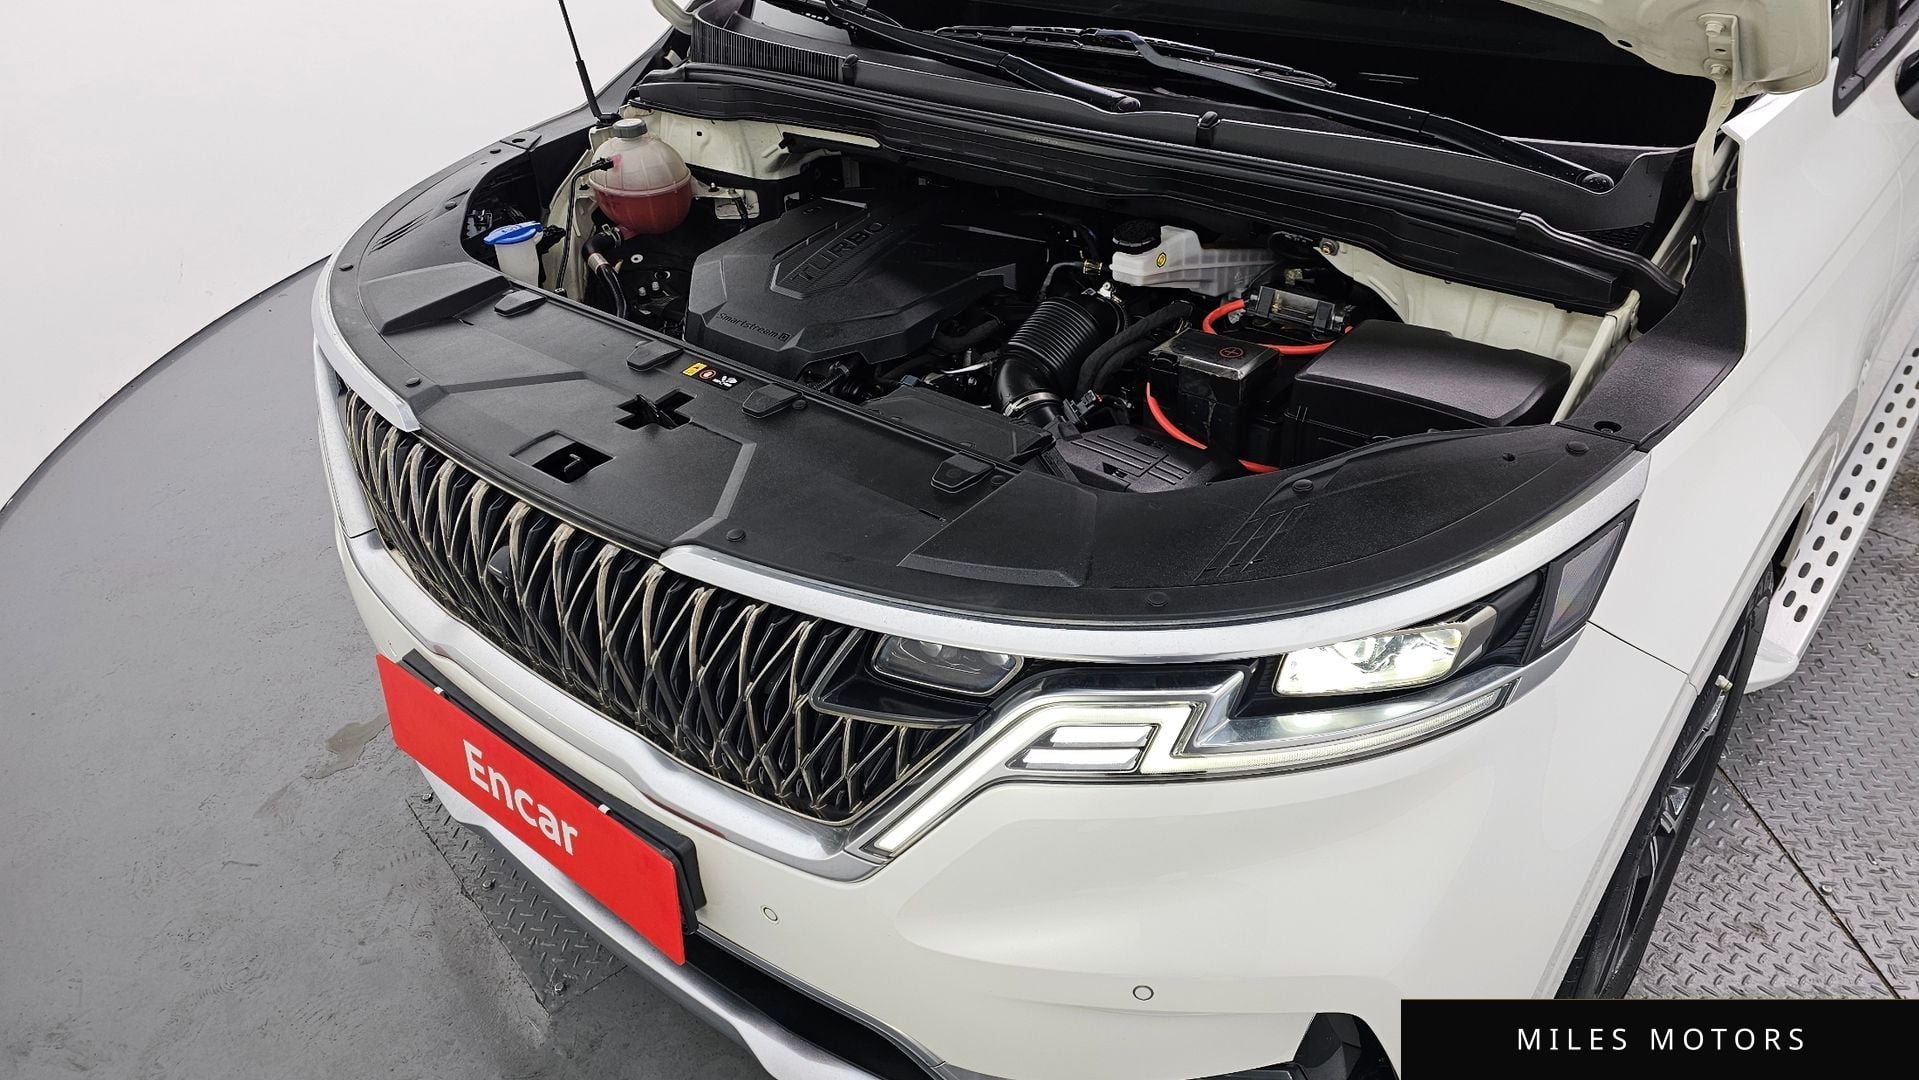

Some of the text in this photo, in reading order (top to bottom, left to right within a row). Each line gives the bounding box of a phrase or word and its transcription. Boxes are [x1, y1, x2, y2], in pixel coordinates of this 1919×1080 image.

[790, 222, 886, 281] TURBO
[716, 312, 779, 338] Smartstream
[463, 739, 578, 856] Encar
